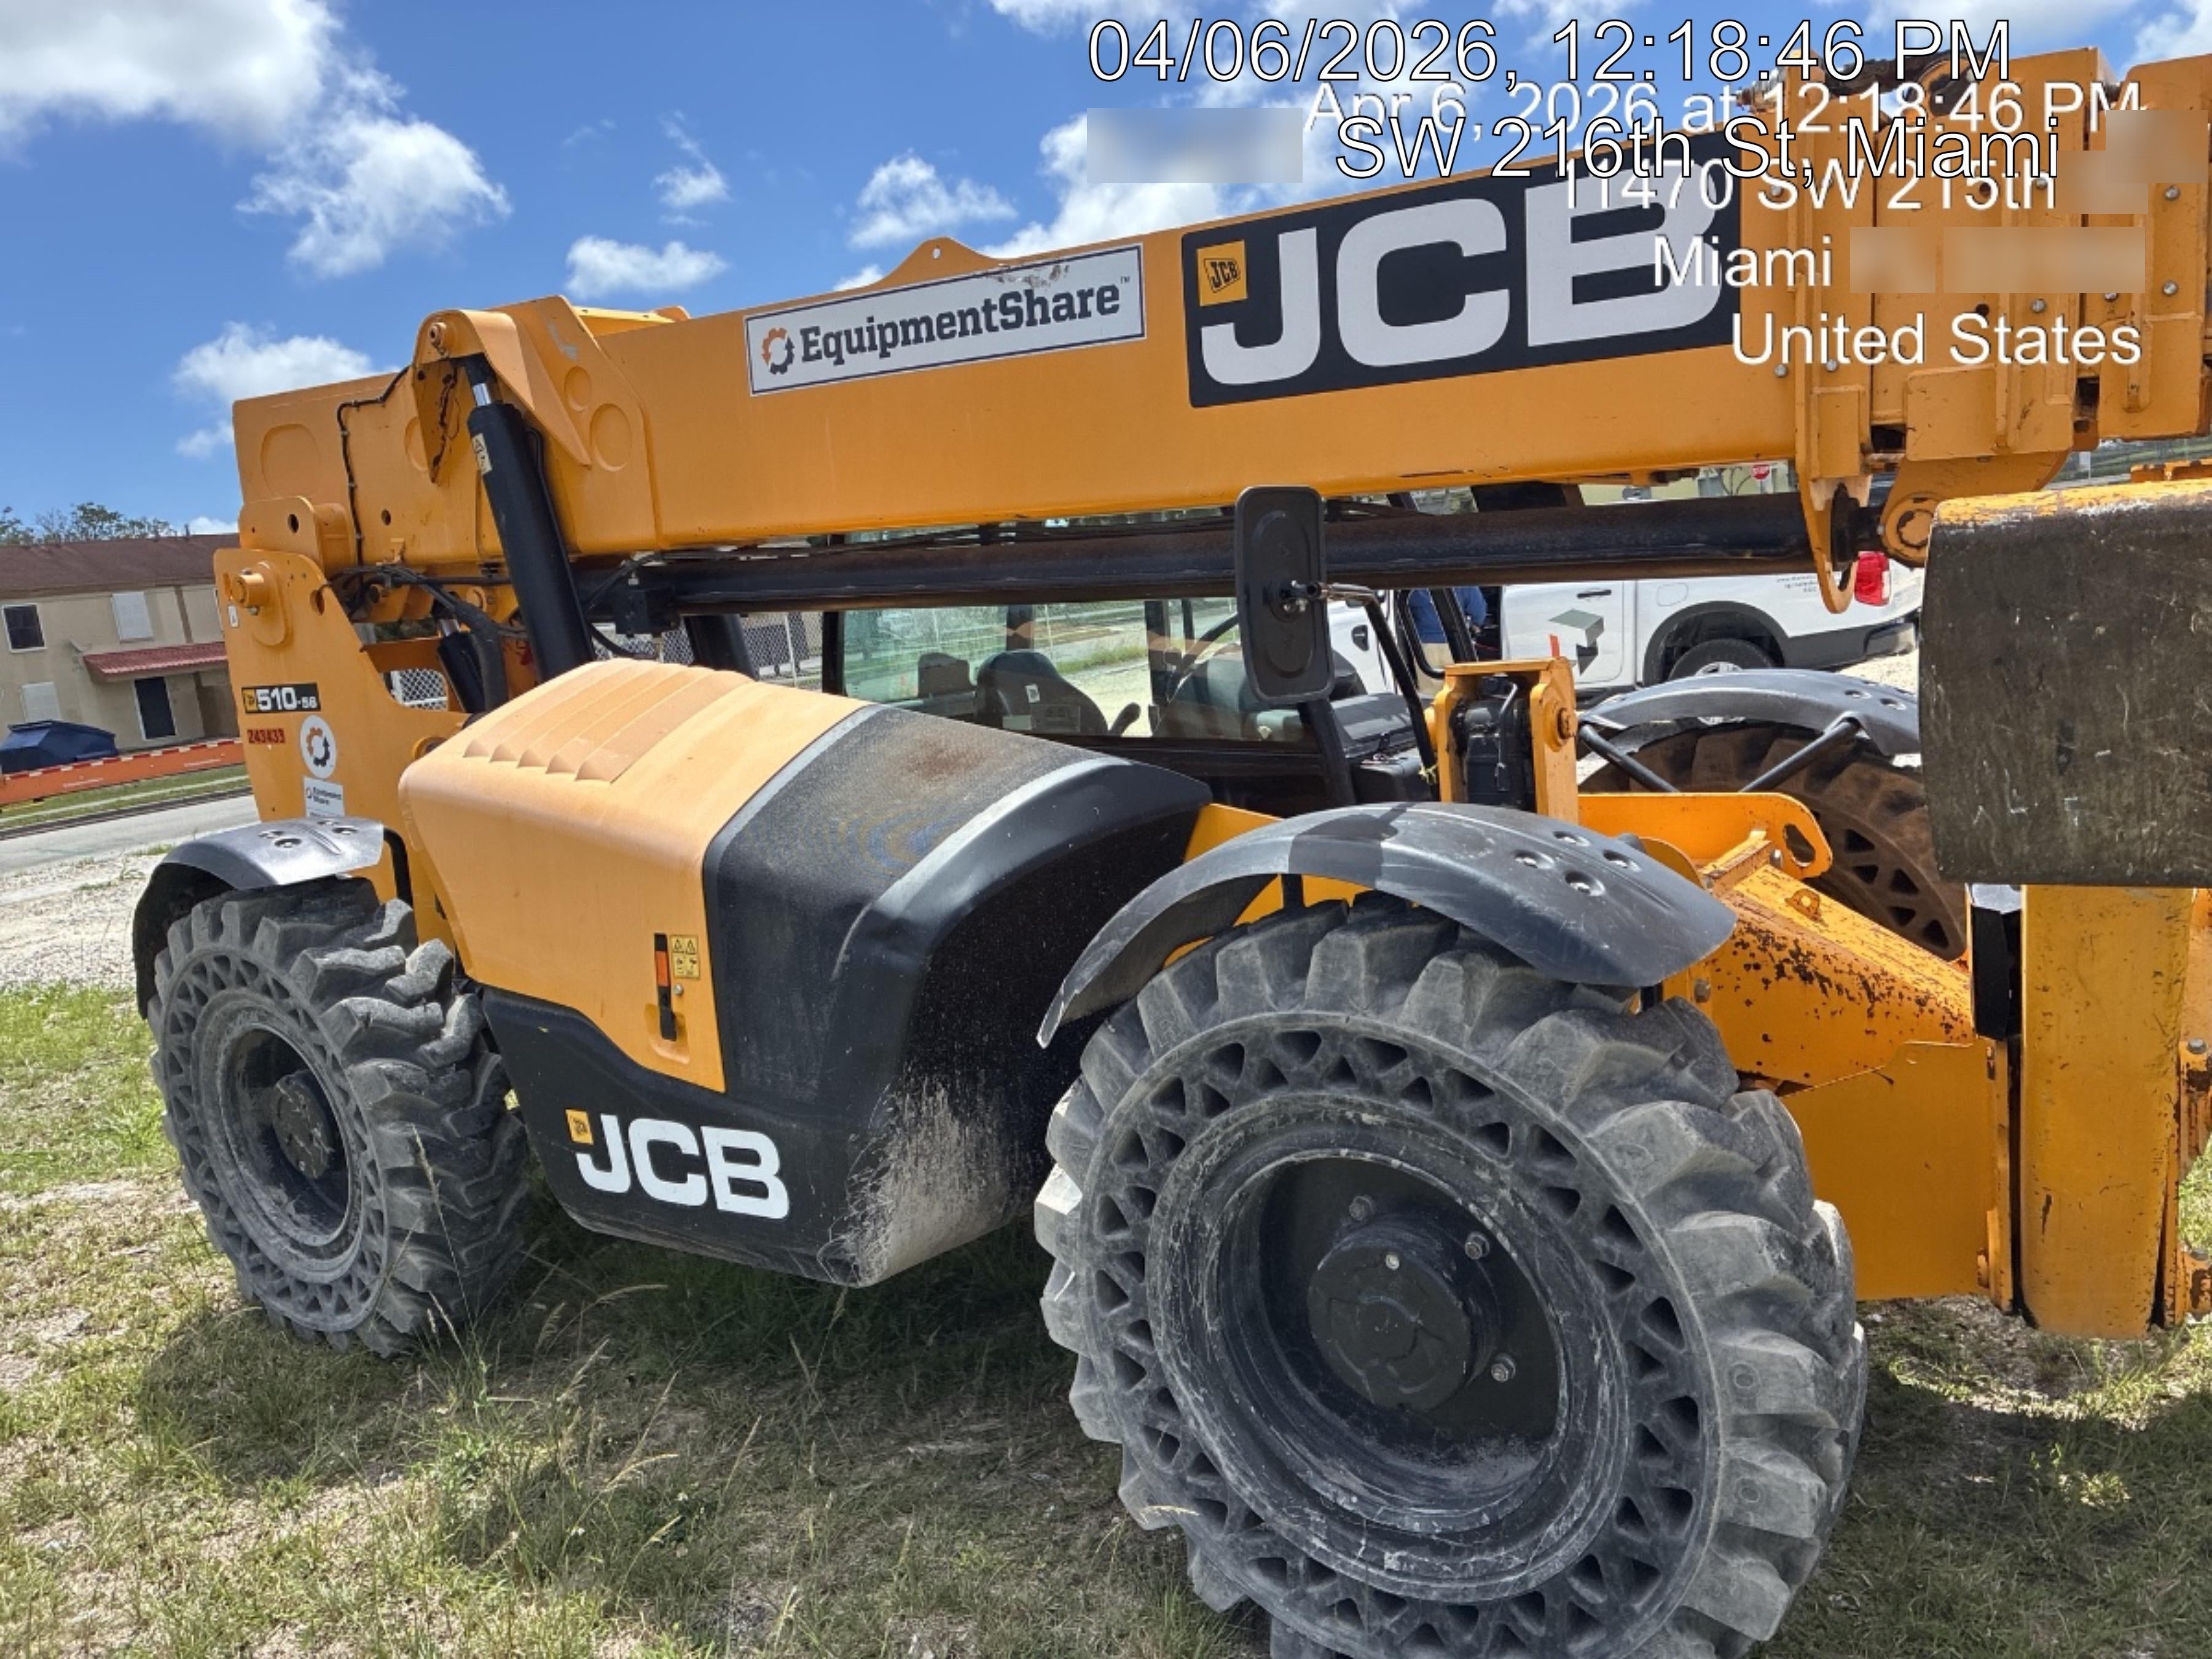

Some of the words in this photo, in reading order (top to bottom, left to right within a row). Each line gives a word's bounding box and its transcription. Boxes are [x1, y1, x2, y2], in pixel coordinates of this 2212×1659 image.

[1201, 167, 1722, 386] JCB
[1209, 261, 1239, 288] JCB
[576, 1114, 790, 1219] JCB
